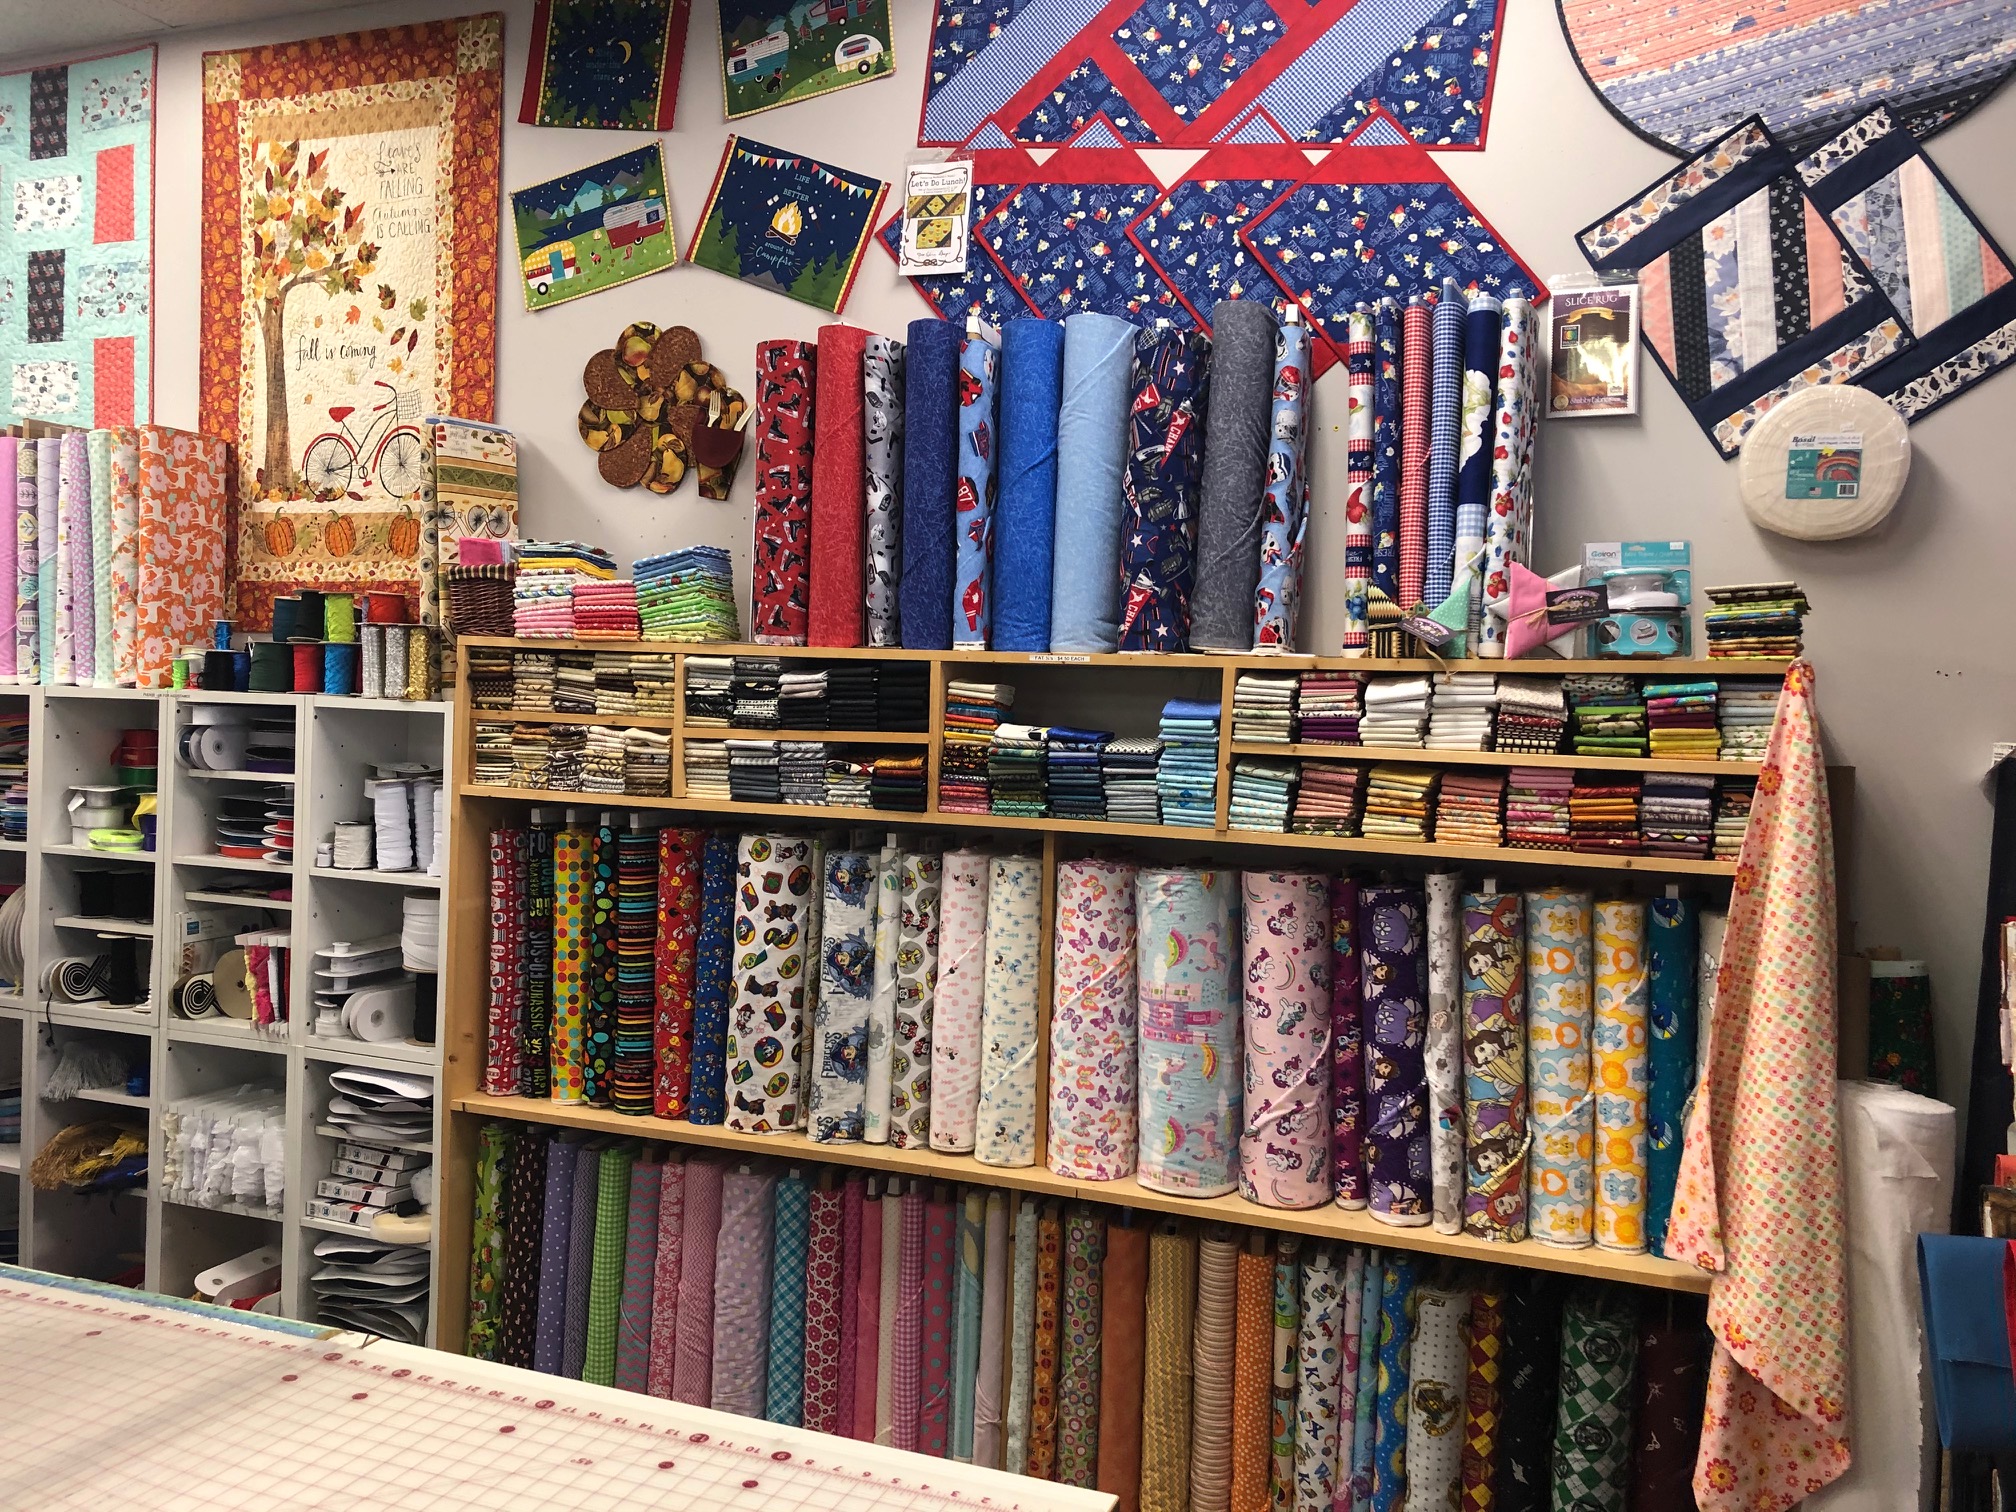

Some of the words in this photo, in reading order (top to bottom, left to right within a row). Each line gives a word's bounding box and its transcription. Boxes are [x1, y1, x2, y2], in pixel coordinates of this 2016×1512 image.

[396, 162, 416, 175] ARE
[794, 173, 811, 184] LIFE
[910, 180, 929, 188] Let's
[930, 179, 940, 187] Do
[941, 177, 966, 186] Lunch!
[379, 176, 423, 200] FALLING
[782, 187, 810, 202] BETTER
[376, 223, 384, 239] IS
[388, 218, 431, 238] CALLING
[1565, 296, 1594, 307] SLICE
[1595, 294, 1618, 304] RUG
[325, 345, 336, 360] is
[340, 344, 377, 369] coming
[958, 485, 973, 502] 87
[488, 1390, 505, 1398] 20
[512, 1395, 527, 1403] 19
[561, 1406, 577, 1414] 17
[588, 1411, 602, 1419] 16
[613, 1417, 628, 1425] 15
[638, 1422, 654, 1430] 14
[665, 1428, 680, 1436] 13
[718, 1440, 734, 1448] 11
[745, 1446, 761, 1454] 10
